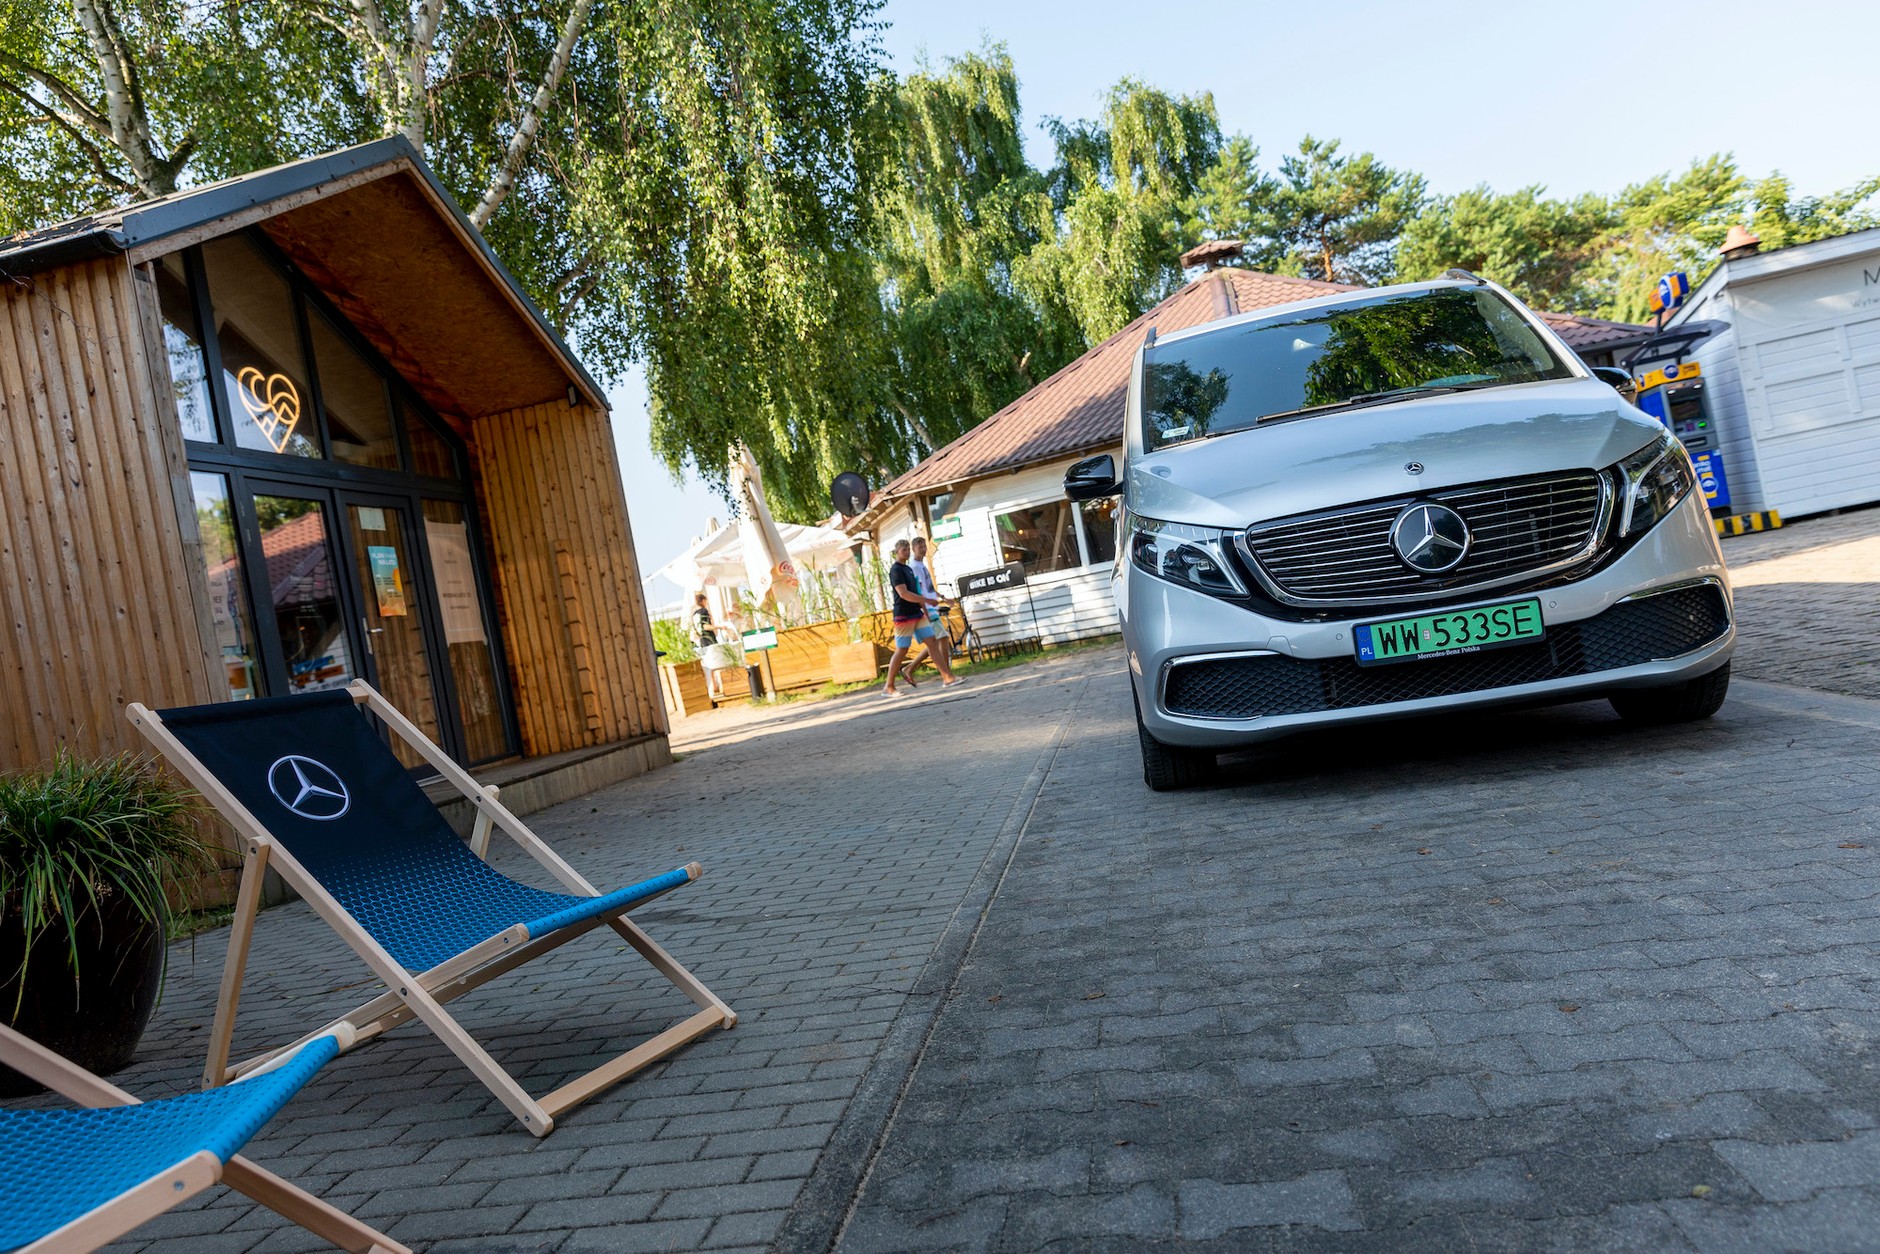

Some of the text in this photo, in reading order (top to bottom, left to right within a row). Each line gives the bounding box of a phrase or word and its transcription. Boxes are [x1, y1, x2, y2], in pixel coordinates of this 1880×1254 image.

[969, 578, 986, 590] BIKE
[986, 576, 996, 586] IS
[1378, 605, 1534, 655] WW 533SE
[1360, 646, 1373, 656] PL
[1417, 645, 1481, 660] Mercedes-Benz Polska
